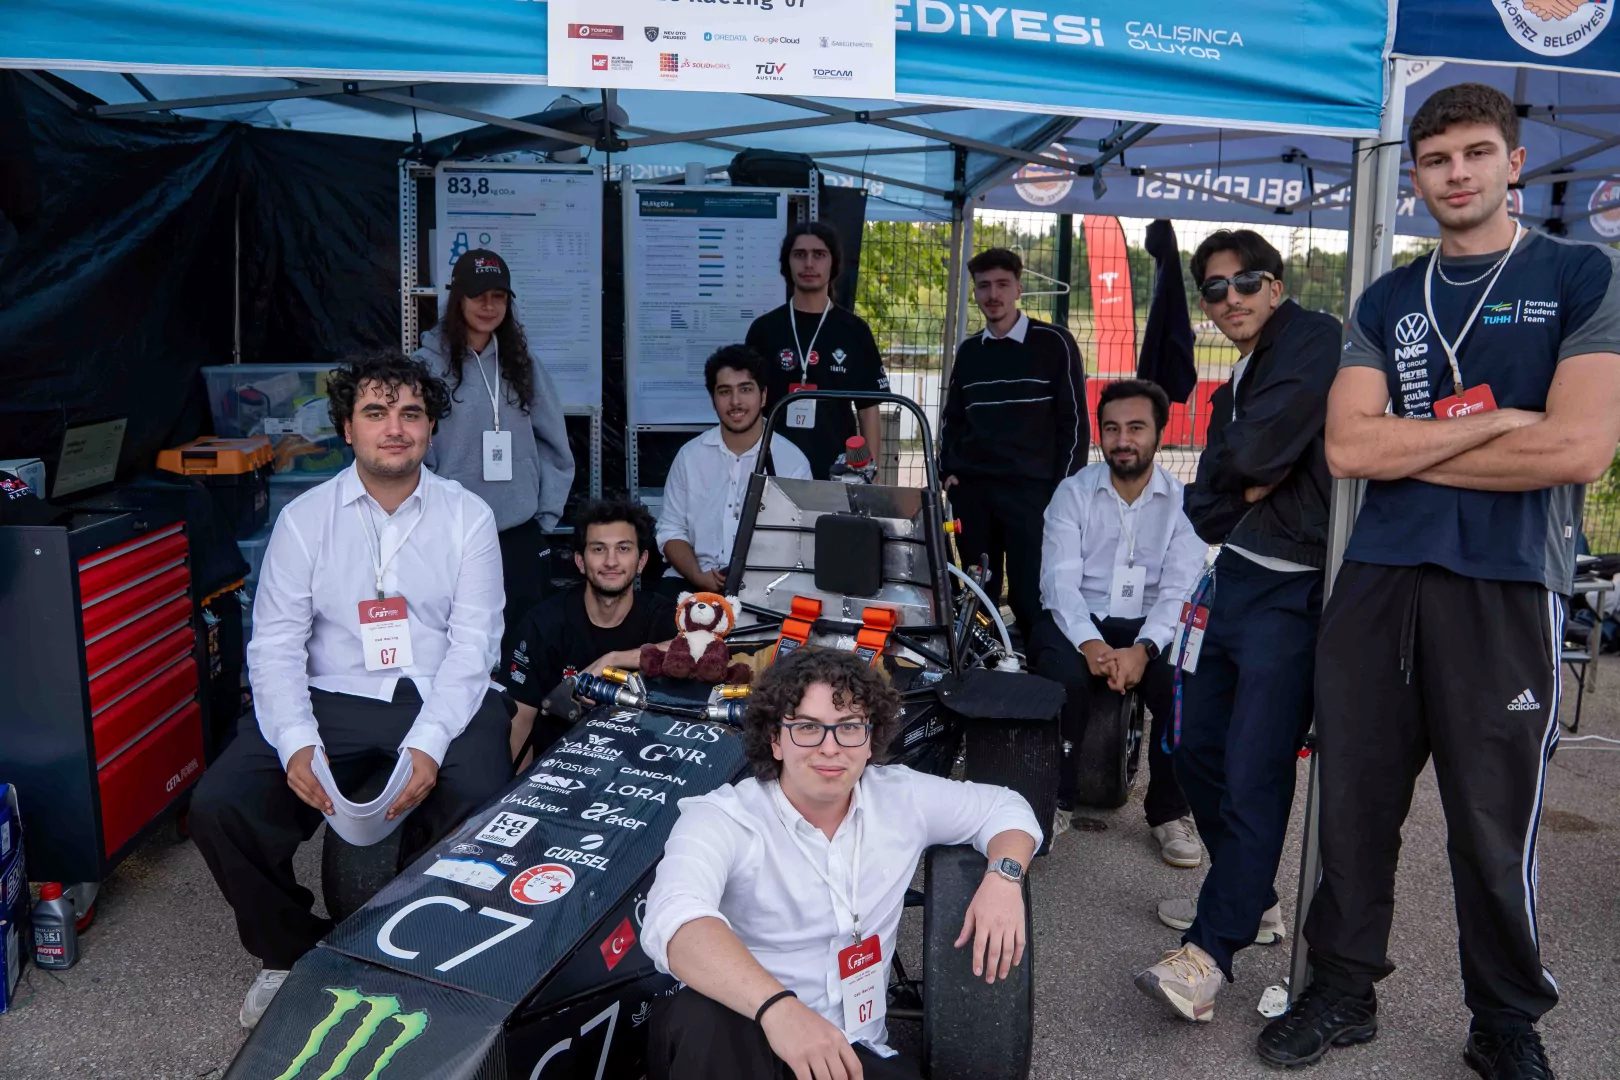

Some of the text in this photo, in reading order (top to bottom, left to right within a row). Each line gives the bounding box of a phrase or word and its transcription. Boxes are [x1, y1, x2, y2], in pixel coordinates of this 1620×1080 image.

[1124, 20, 1244, 47] ÇALIŞINCA
[1543, 6, 1607, 48] BELEDİYESİ
[753, 35, 800, 45] Google Cloud
[1128, 38, 1221, 61] OLUYOR
[692, 62, 731, 70] SOLIDWORKS
[755, 62, 787, 75] TÜV
[813, 68, 853, 77] TOPCAM
[447, 177, 490, 198] 83,8
[1523, 308, 1556, 316] Student
[1524, 300, 1558, 308] Formula
[1483, 315, 1512, 325] TUHH
[1522, 315, 1545, 323] Team
[1394, 343, 1429, 362] NXP
[1407, 359, 1428, 368] GROUP
[380, 648, 397, 665] C7
[1507, 701, 1541, 711] adidas
[663, 720, 726, 743] EGS
[639, 743, 707, 766] GNR
[166, 773, 181, 792] CETA
[619, 767, 687, 786] CANCAN
[528, 782, 572, 796] AUTOMOTIVE
[604, 782, 668, 805] LORA
[501, 793, 569, 814] Unilever
[495, 813, 528, 829] ka
[489, 824, 521, 837] re
[543, 846, 611, 872] GÜRSEL
[376, 895, 534, 972] C7
[37, 947, 63, 955] MOTUL
[859, 999, 873, 1023] C7
